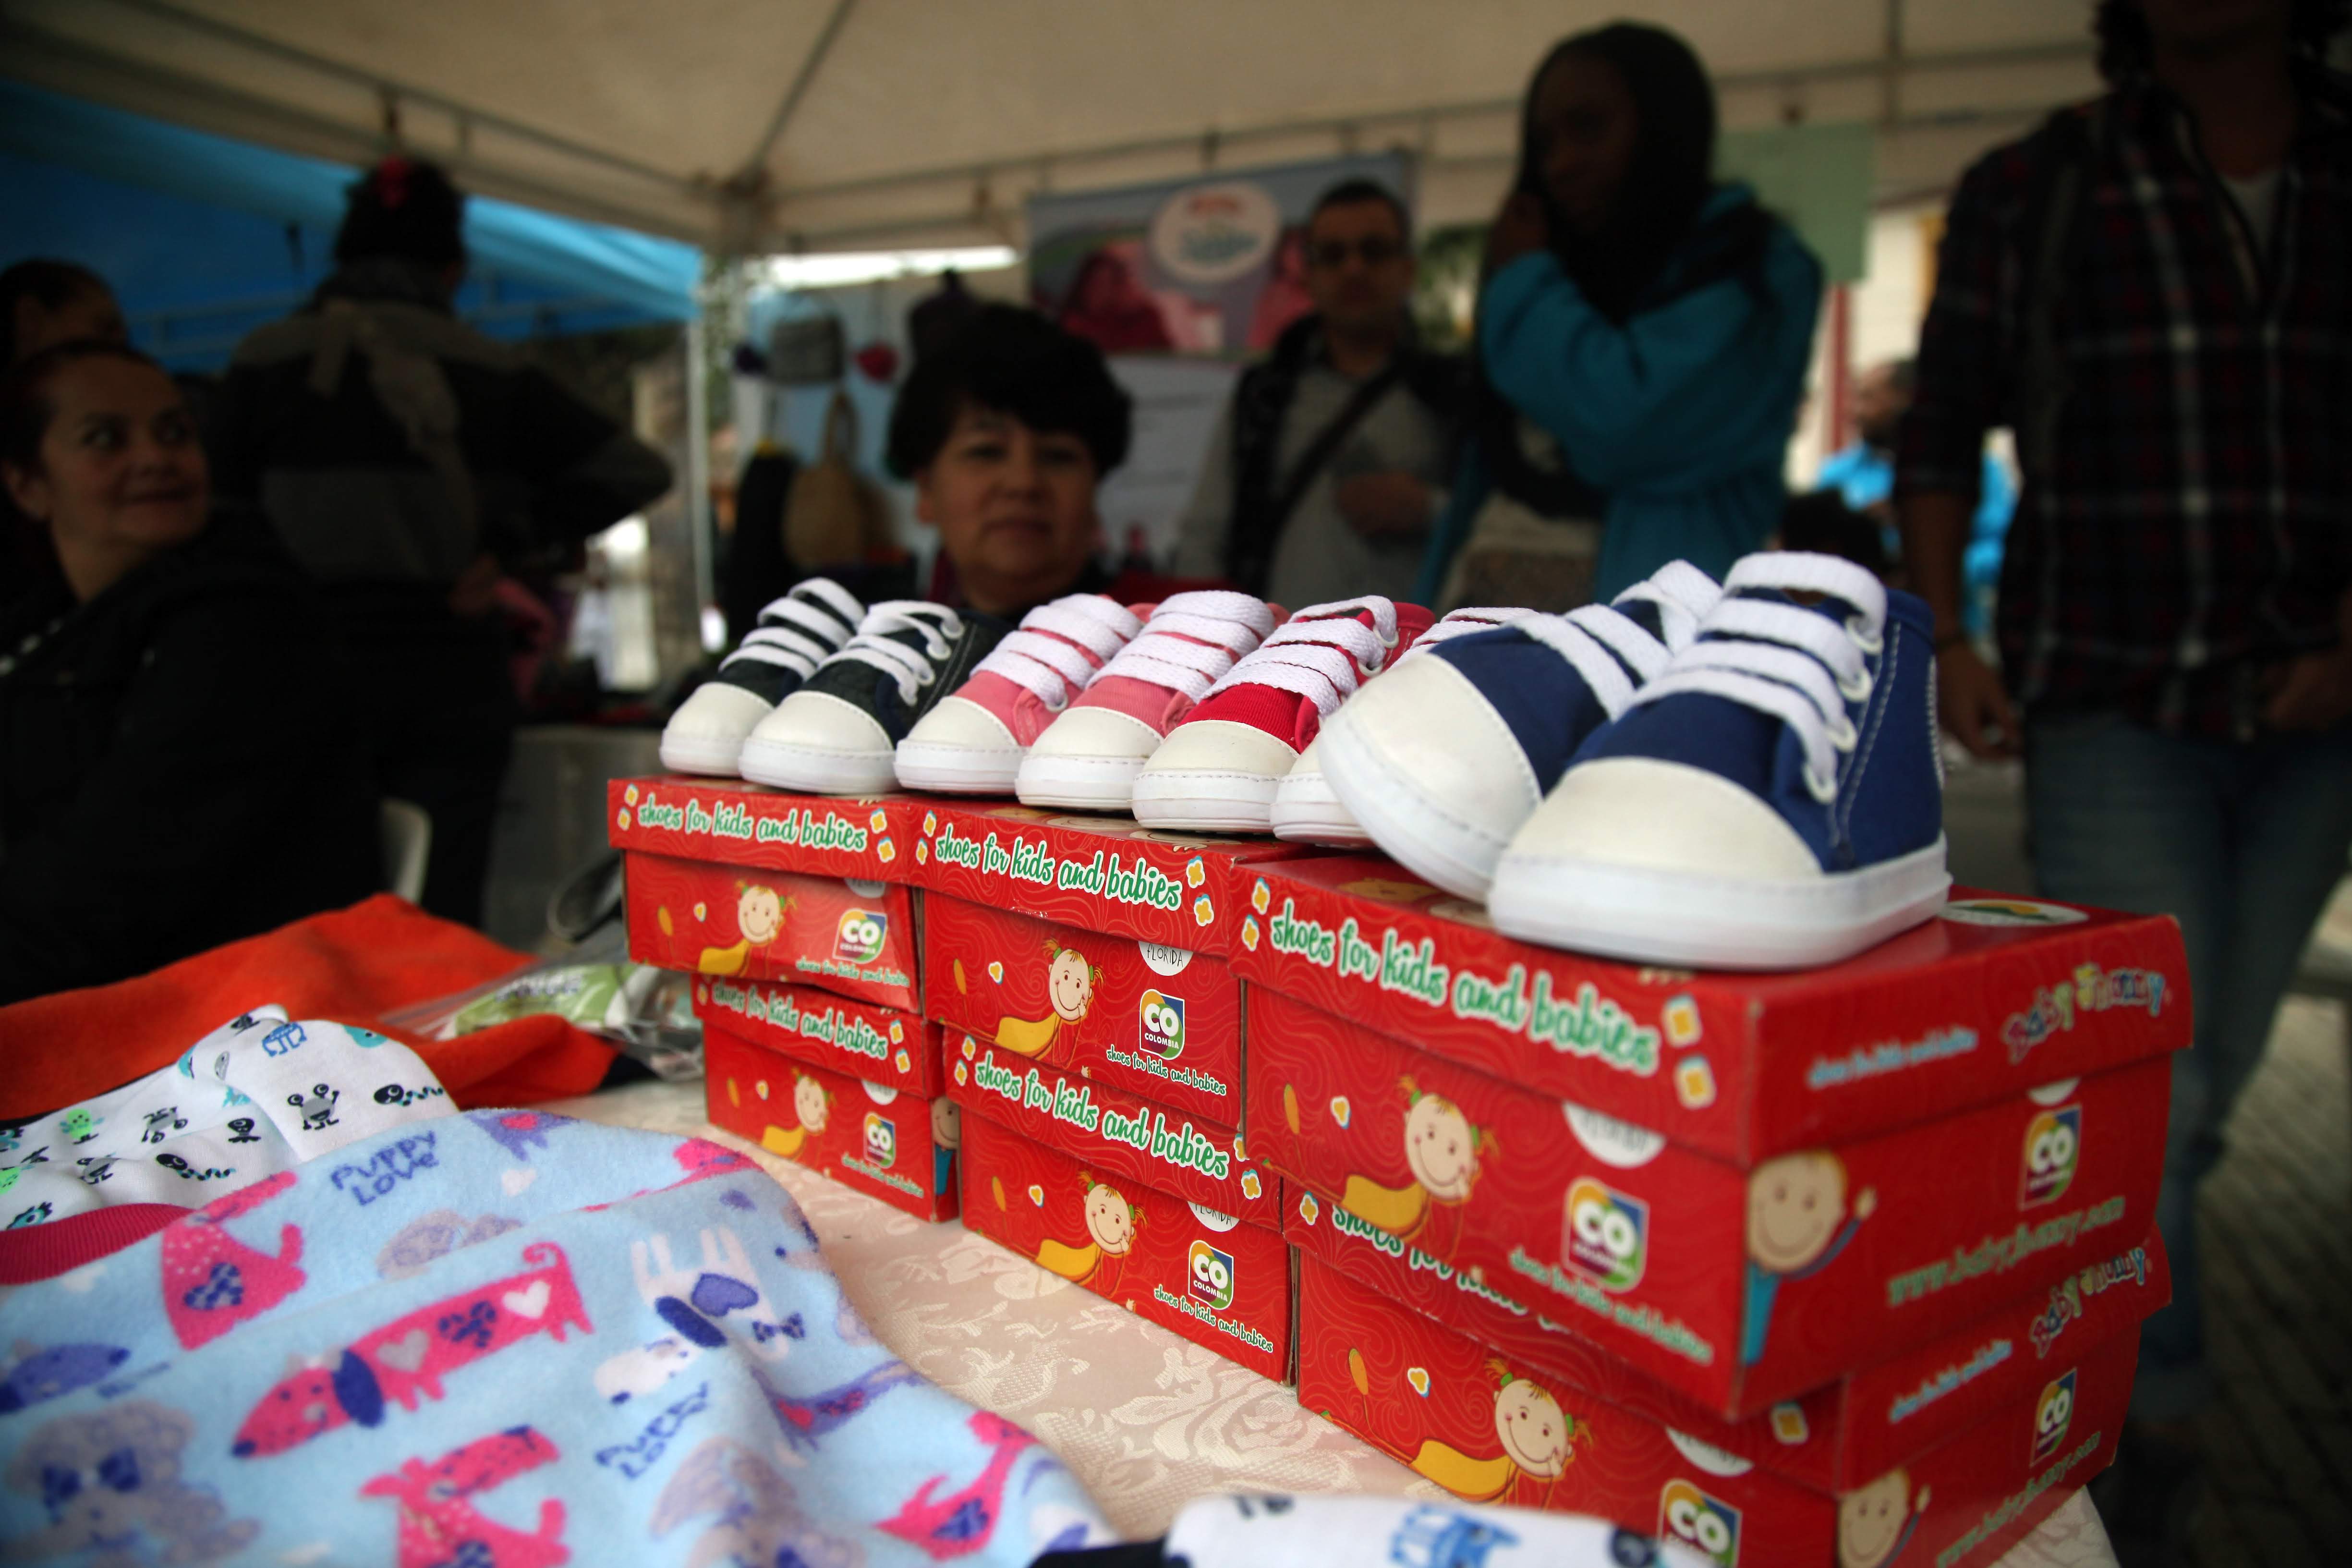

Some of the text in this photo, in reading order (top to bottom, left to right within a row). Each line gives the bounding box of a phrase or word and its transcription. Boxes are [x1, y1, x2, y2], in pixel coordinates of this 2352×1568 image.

[639, 792, 867, 851] shoes for kids and babies
[935, 823, 1182, 911] shoes for kids and babies
[842, 919, 880, 945] CO
[1147, 942, 1184, 968] FLORIDA
[1270, 898, 1662, 1077] shoes for kids and babies
[712, 977, 888, 1060] shoes for kids and babies
[1144, 1003, 1179, 1037] CO
[1145, 1033, 1179, 1049] COLOMBIA
[1106, 1044, 1226, 1096] shoes for kids and babies
[868, 1124, 892, 1152] CO
[975, 1050, 1229, 1180] shoes for kids and babies
[1575, 1200, 1635, 1257] CO
[1193, 1280, 1228, 1302] COLOMBIA
[1194, 1254, 1228, 1289] CO
[1154, 1284, 1273, 1353] shoes for kids and babies
[2039, 1388, 2070, 1434] CO
[1670, 1499, 1730, 1554] CO
